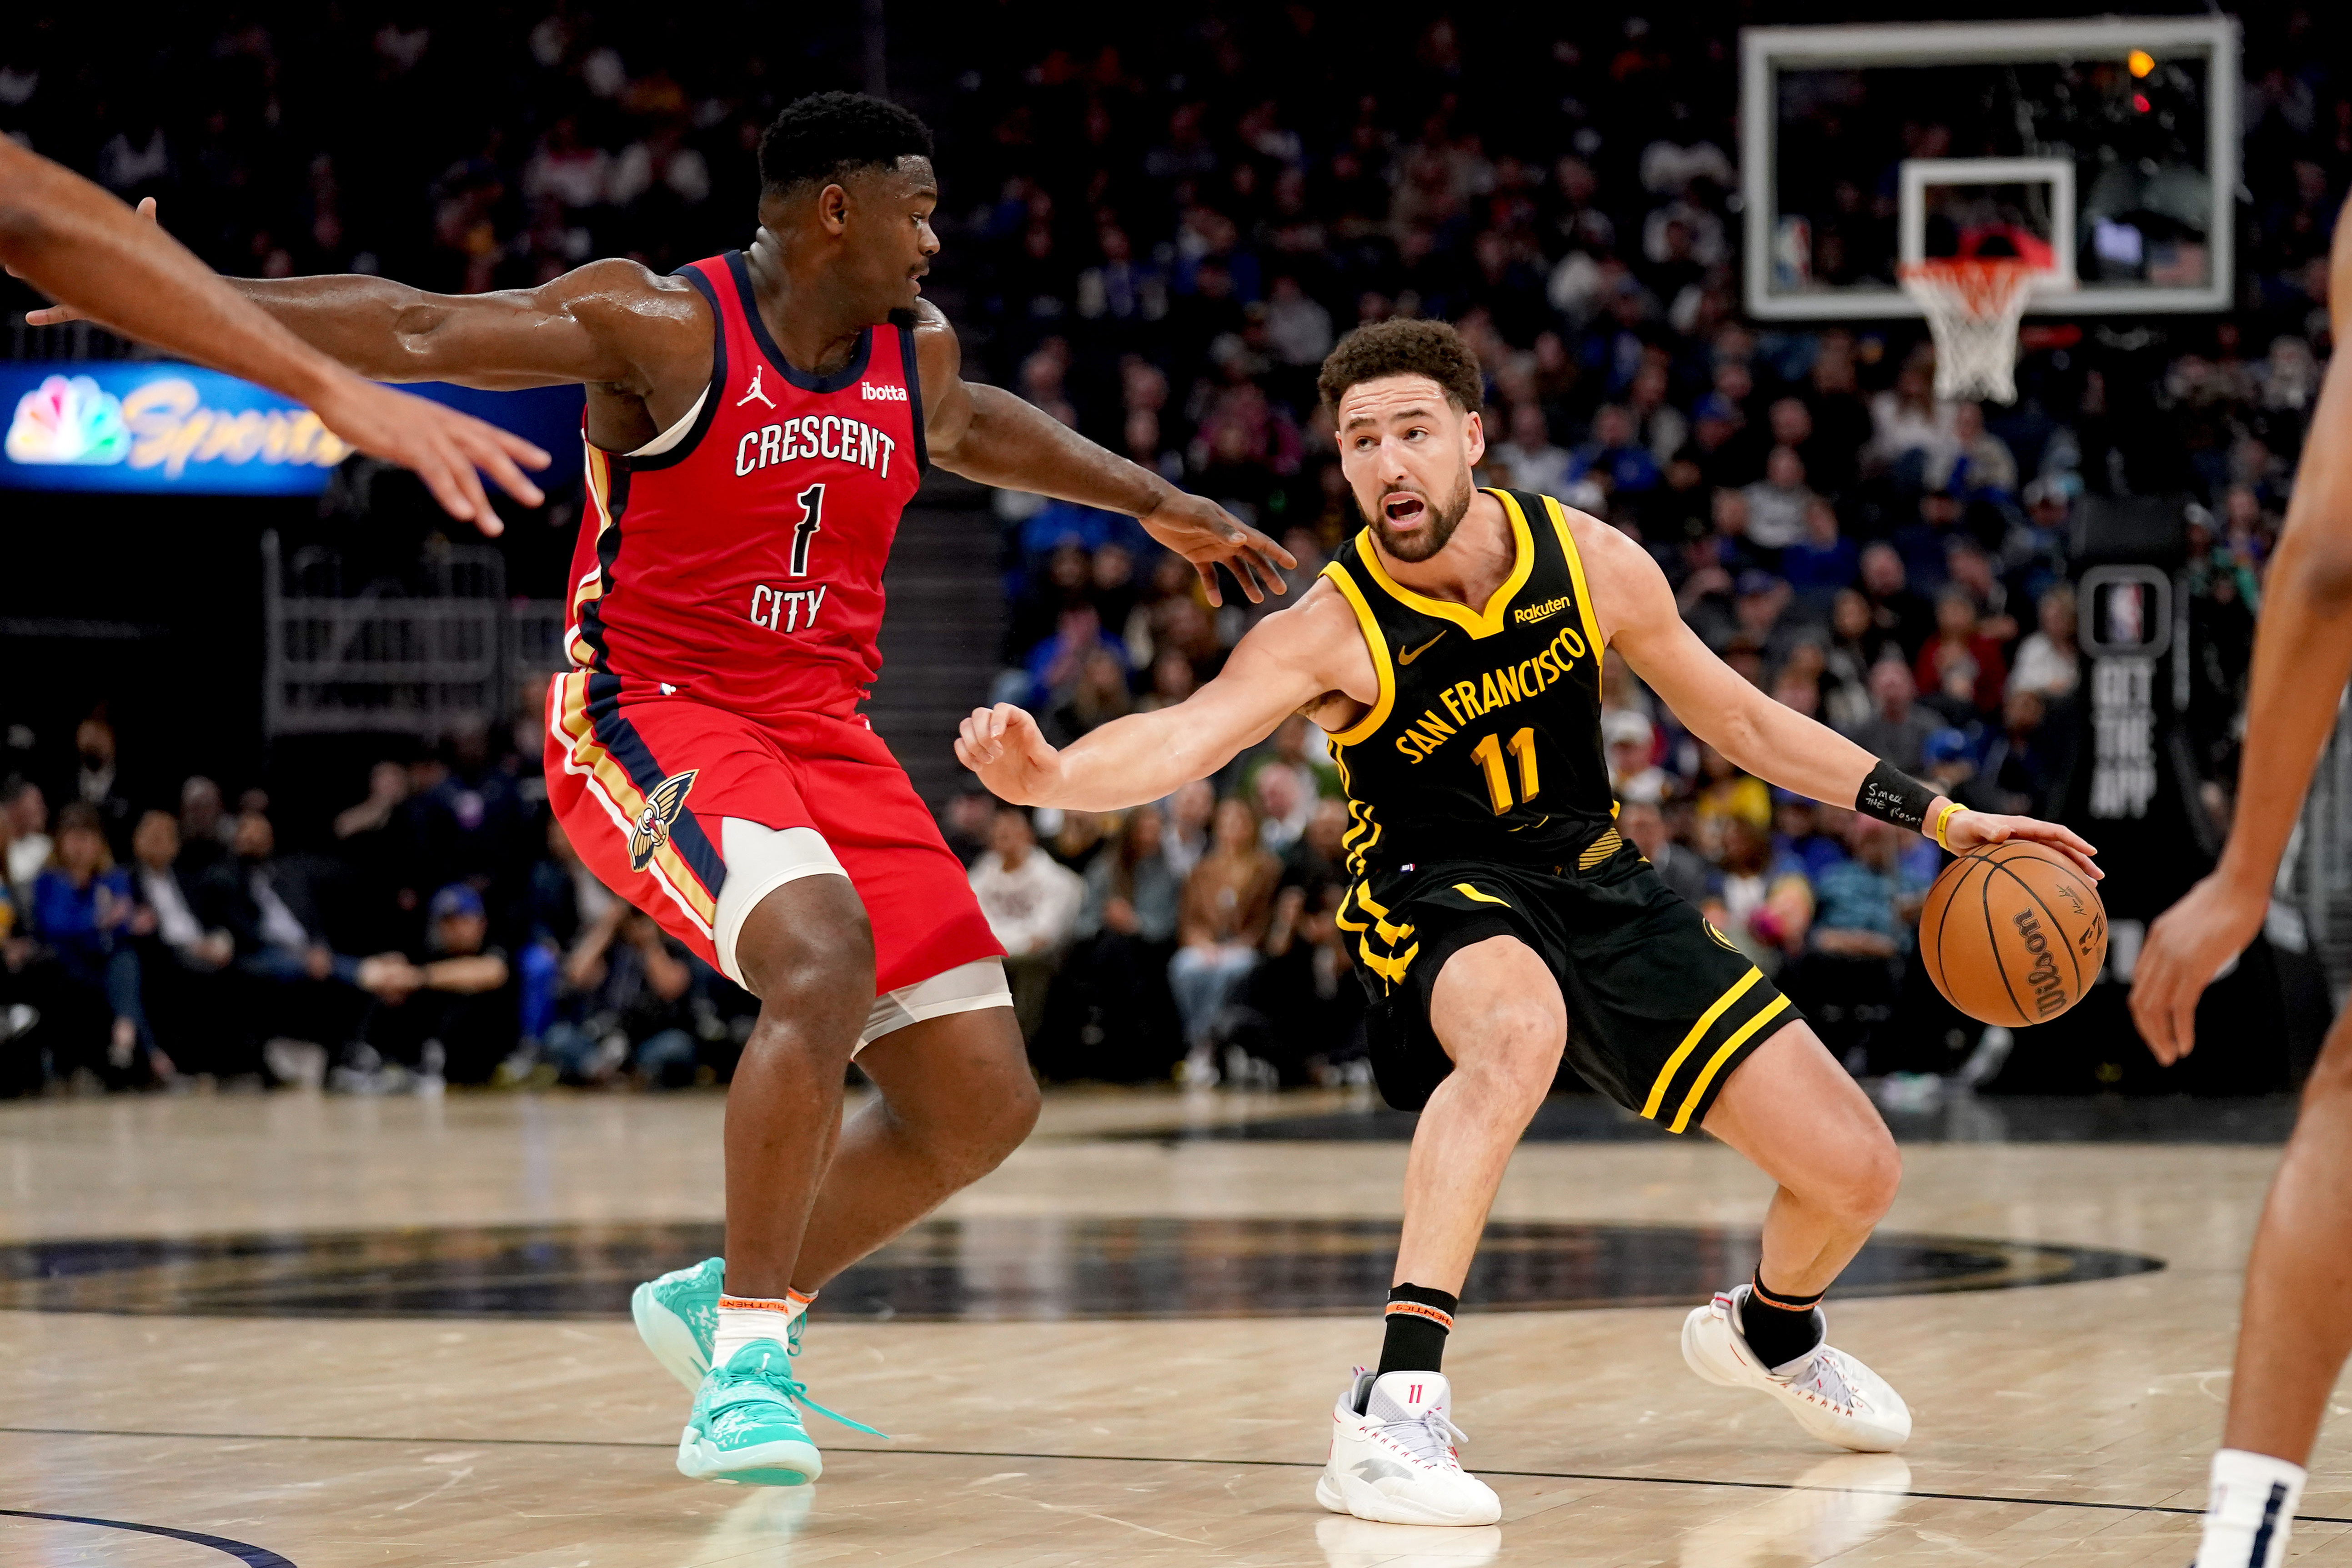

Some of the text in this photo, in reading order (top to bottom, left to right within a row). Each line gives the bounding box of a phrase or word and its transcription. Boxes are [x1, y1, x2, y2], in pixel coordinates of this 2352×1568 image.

[862, 381, 908, 401] ibotta
[735, 415, 895, 479] CRESCENT
[790, 483, 825, 576] 1
[750, 584, 827, 632] CITY
[1515, 596, 1570, 623] Rakuten
[1396, 627, 1585, 764] SAN FRANCISCO
[1470, 727, 1540, 816] 11
[2013, 906, 2067, 1018] Wilson
[1409, 1384, 1422, 1403] 11
